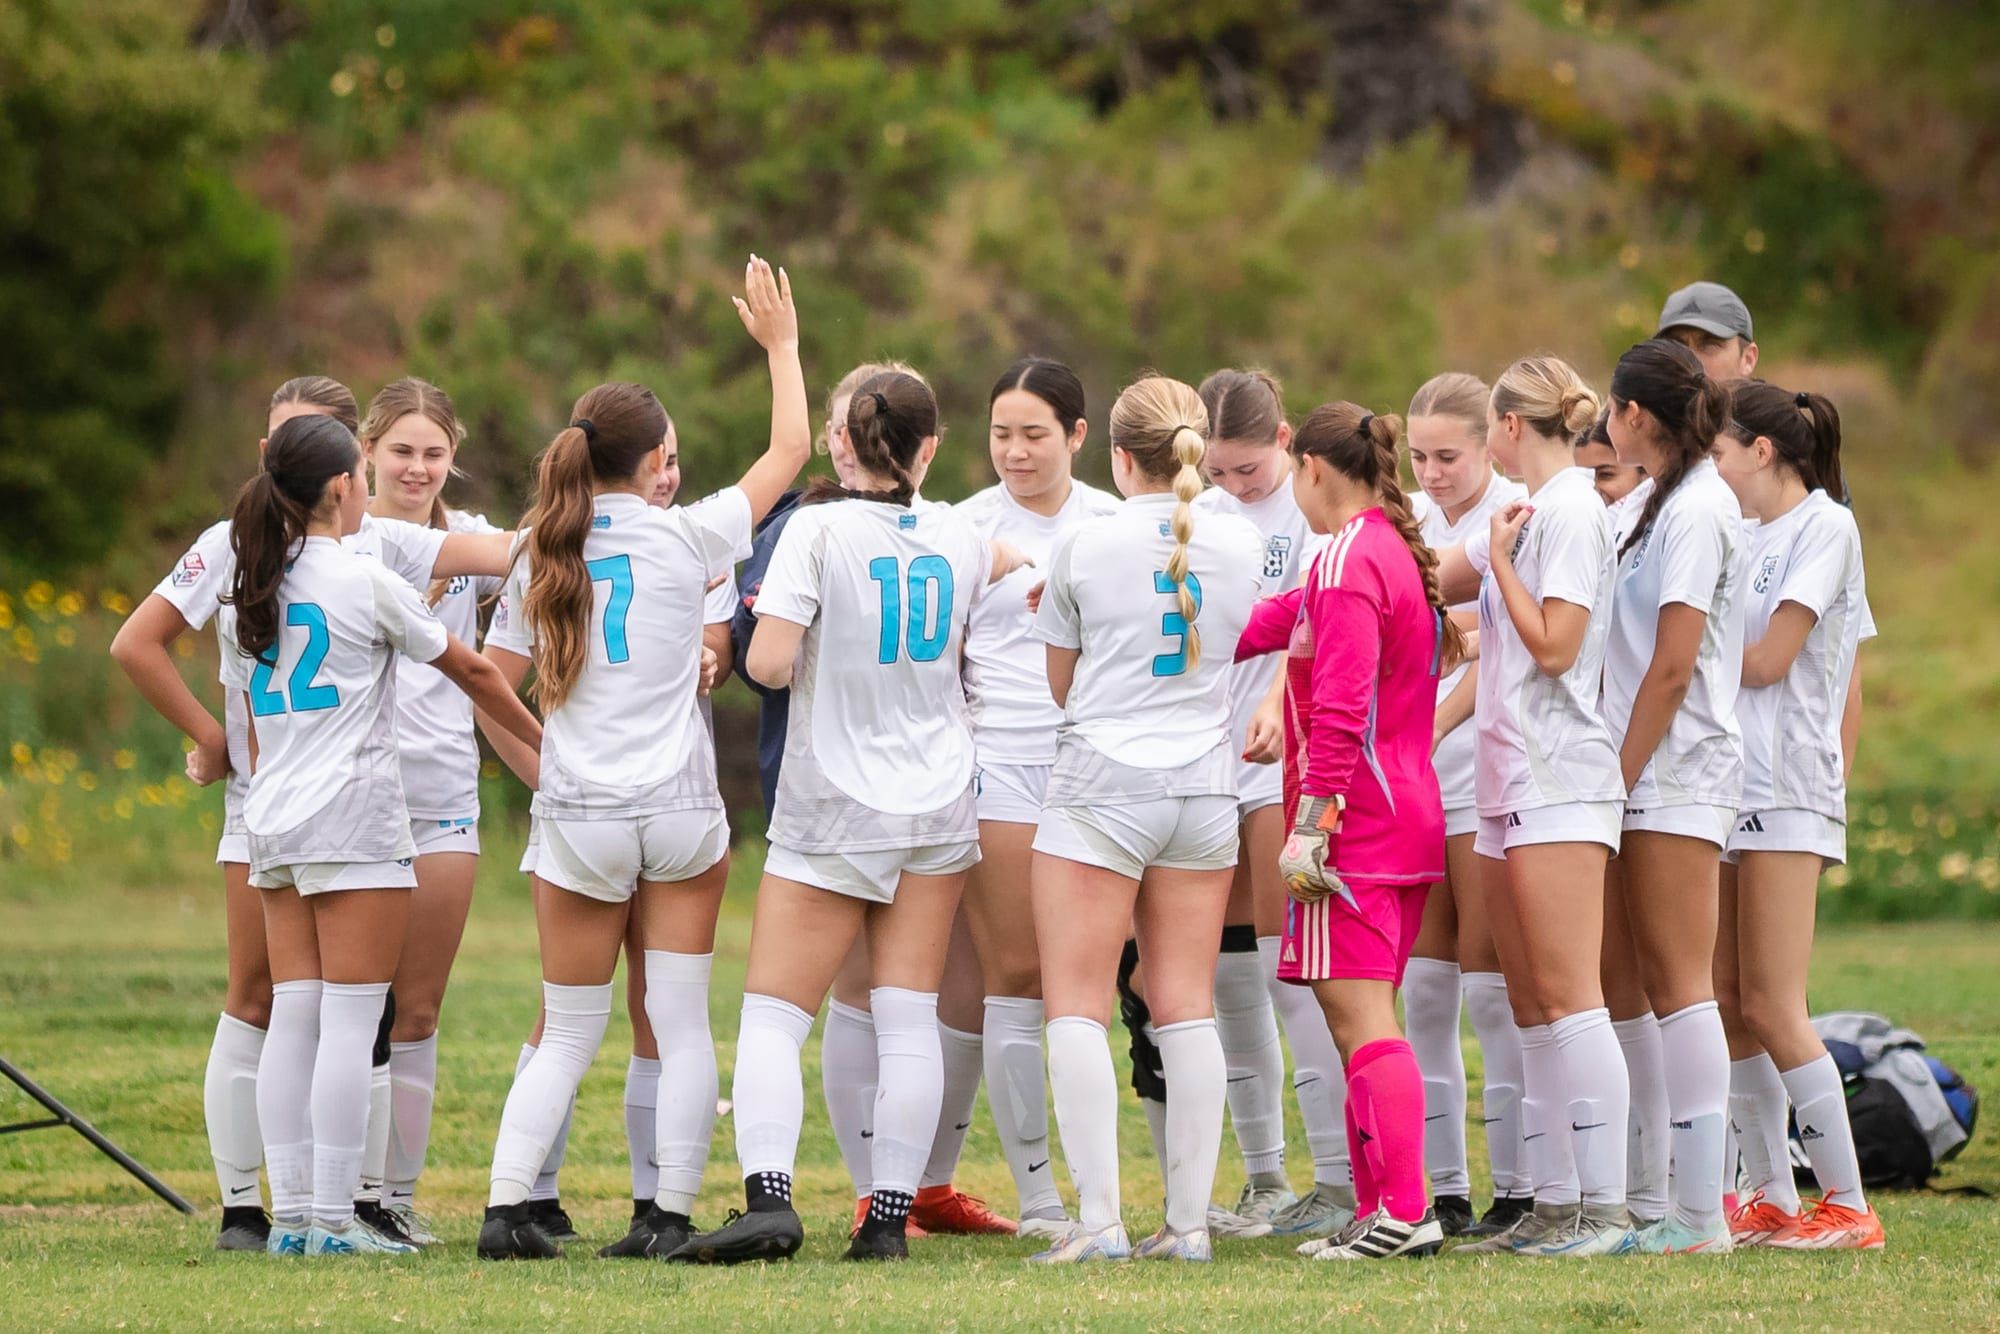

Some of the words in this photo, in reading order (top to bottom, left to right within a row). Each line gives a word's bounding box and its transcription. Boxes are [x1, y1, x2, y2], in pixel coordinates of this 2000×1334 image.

[588, 553, 634, 664] 7
[869, 555, 954, 665] 10
[1152, 570, 1202, 677] 3
